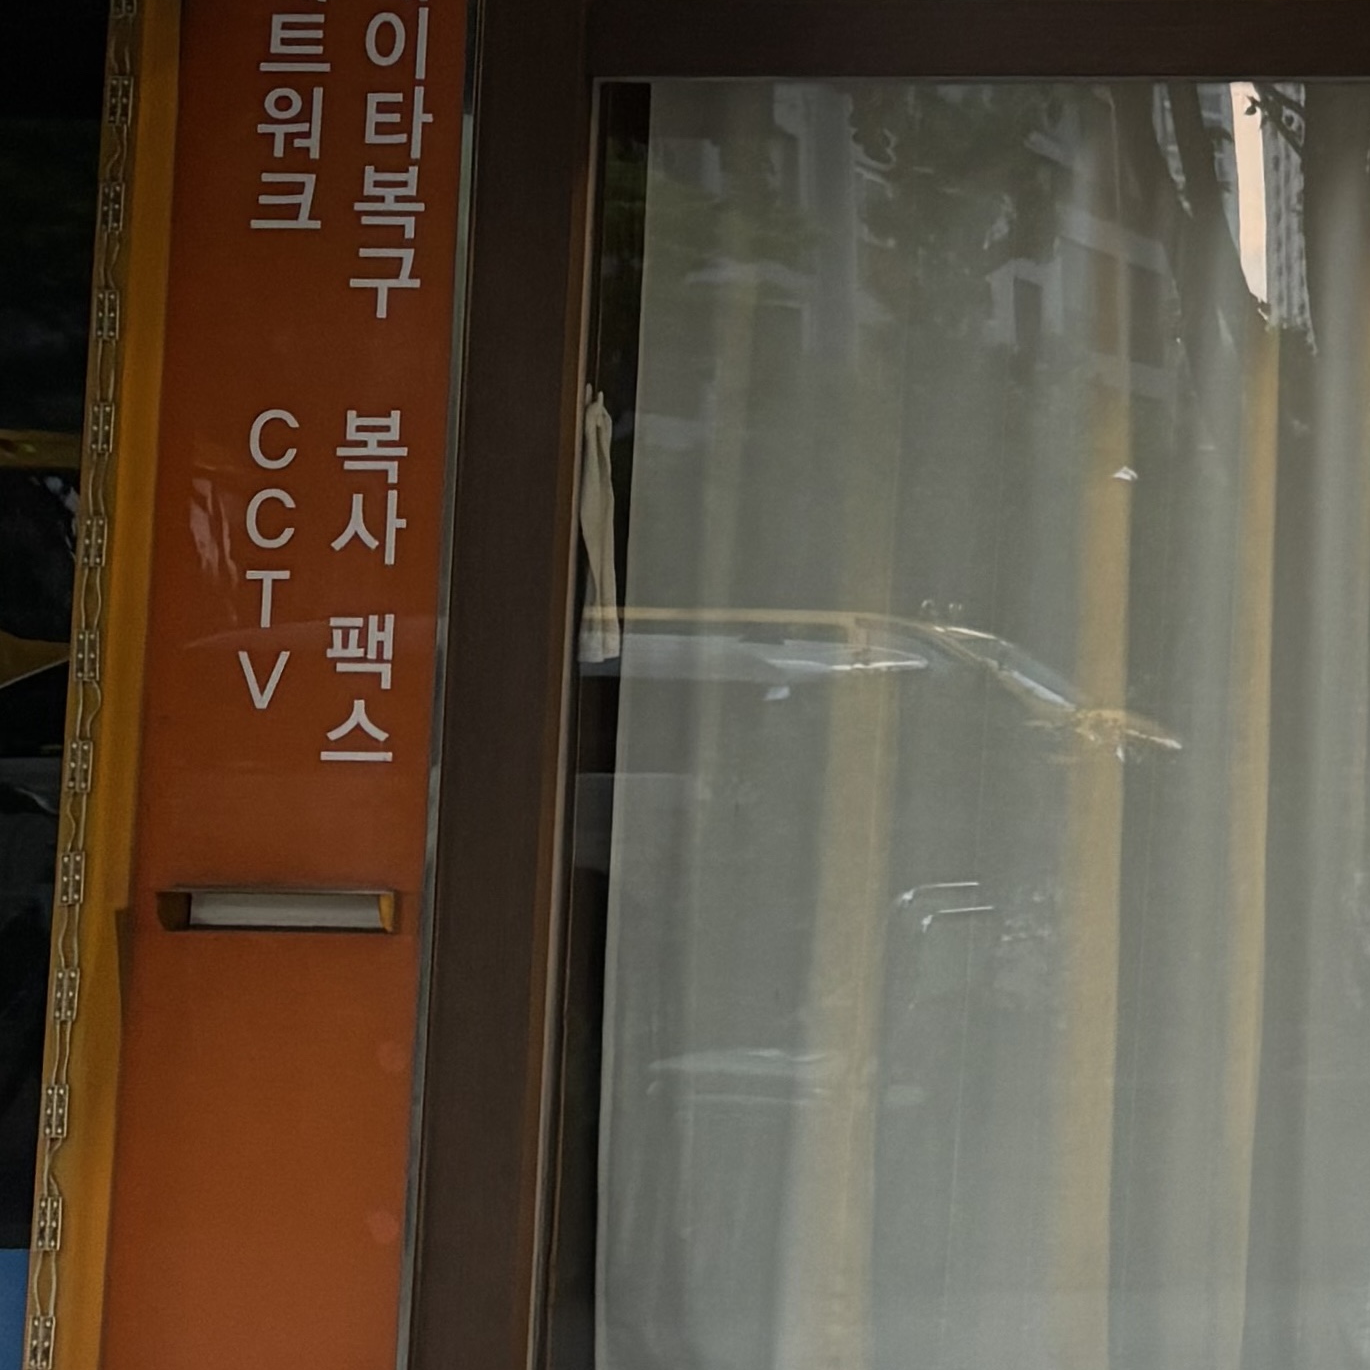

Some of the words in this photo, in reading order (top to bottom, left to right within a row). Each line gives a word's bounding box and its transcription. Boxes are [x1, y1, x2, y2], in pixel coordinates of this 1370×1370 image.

[237, 408, 300, 710] CCTV
[331, 409, 408, 565] 복사
[320, 613, 396, 762] 팩스
